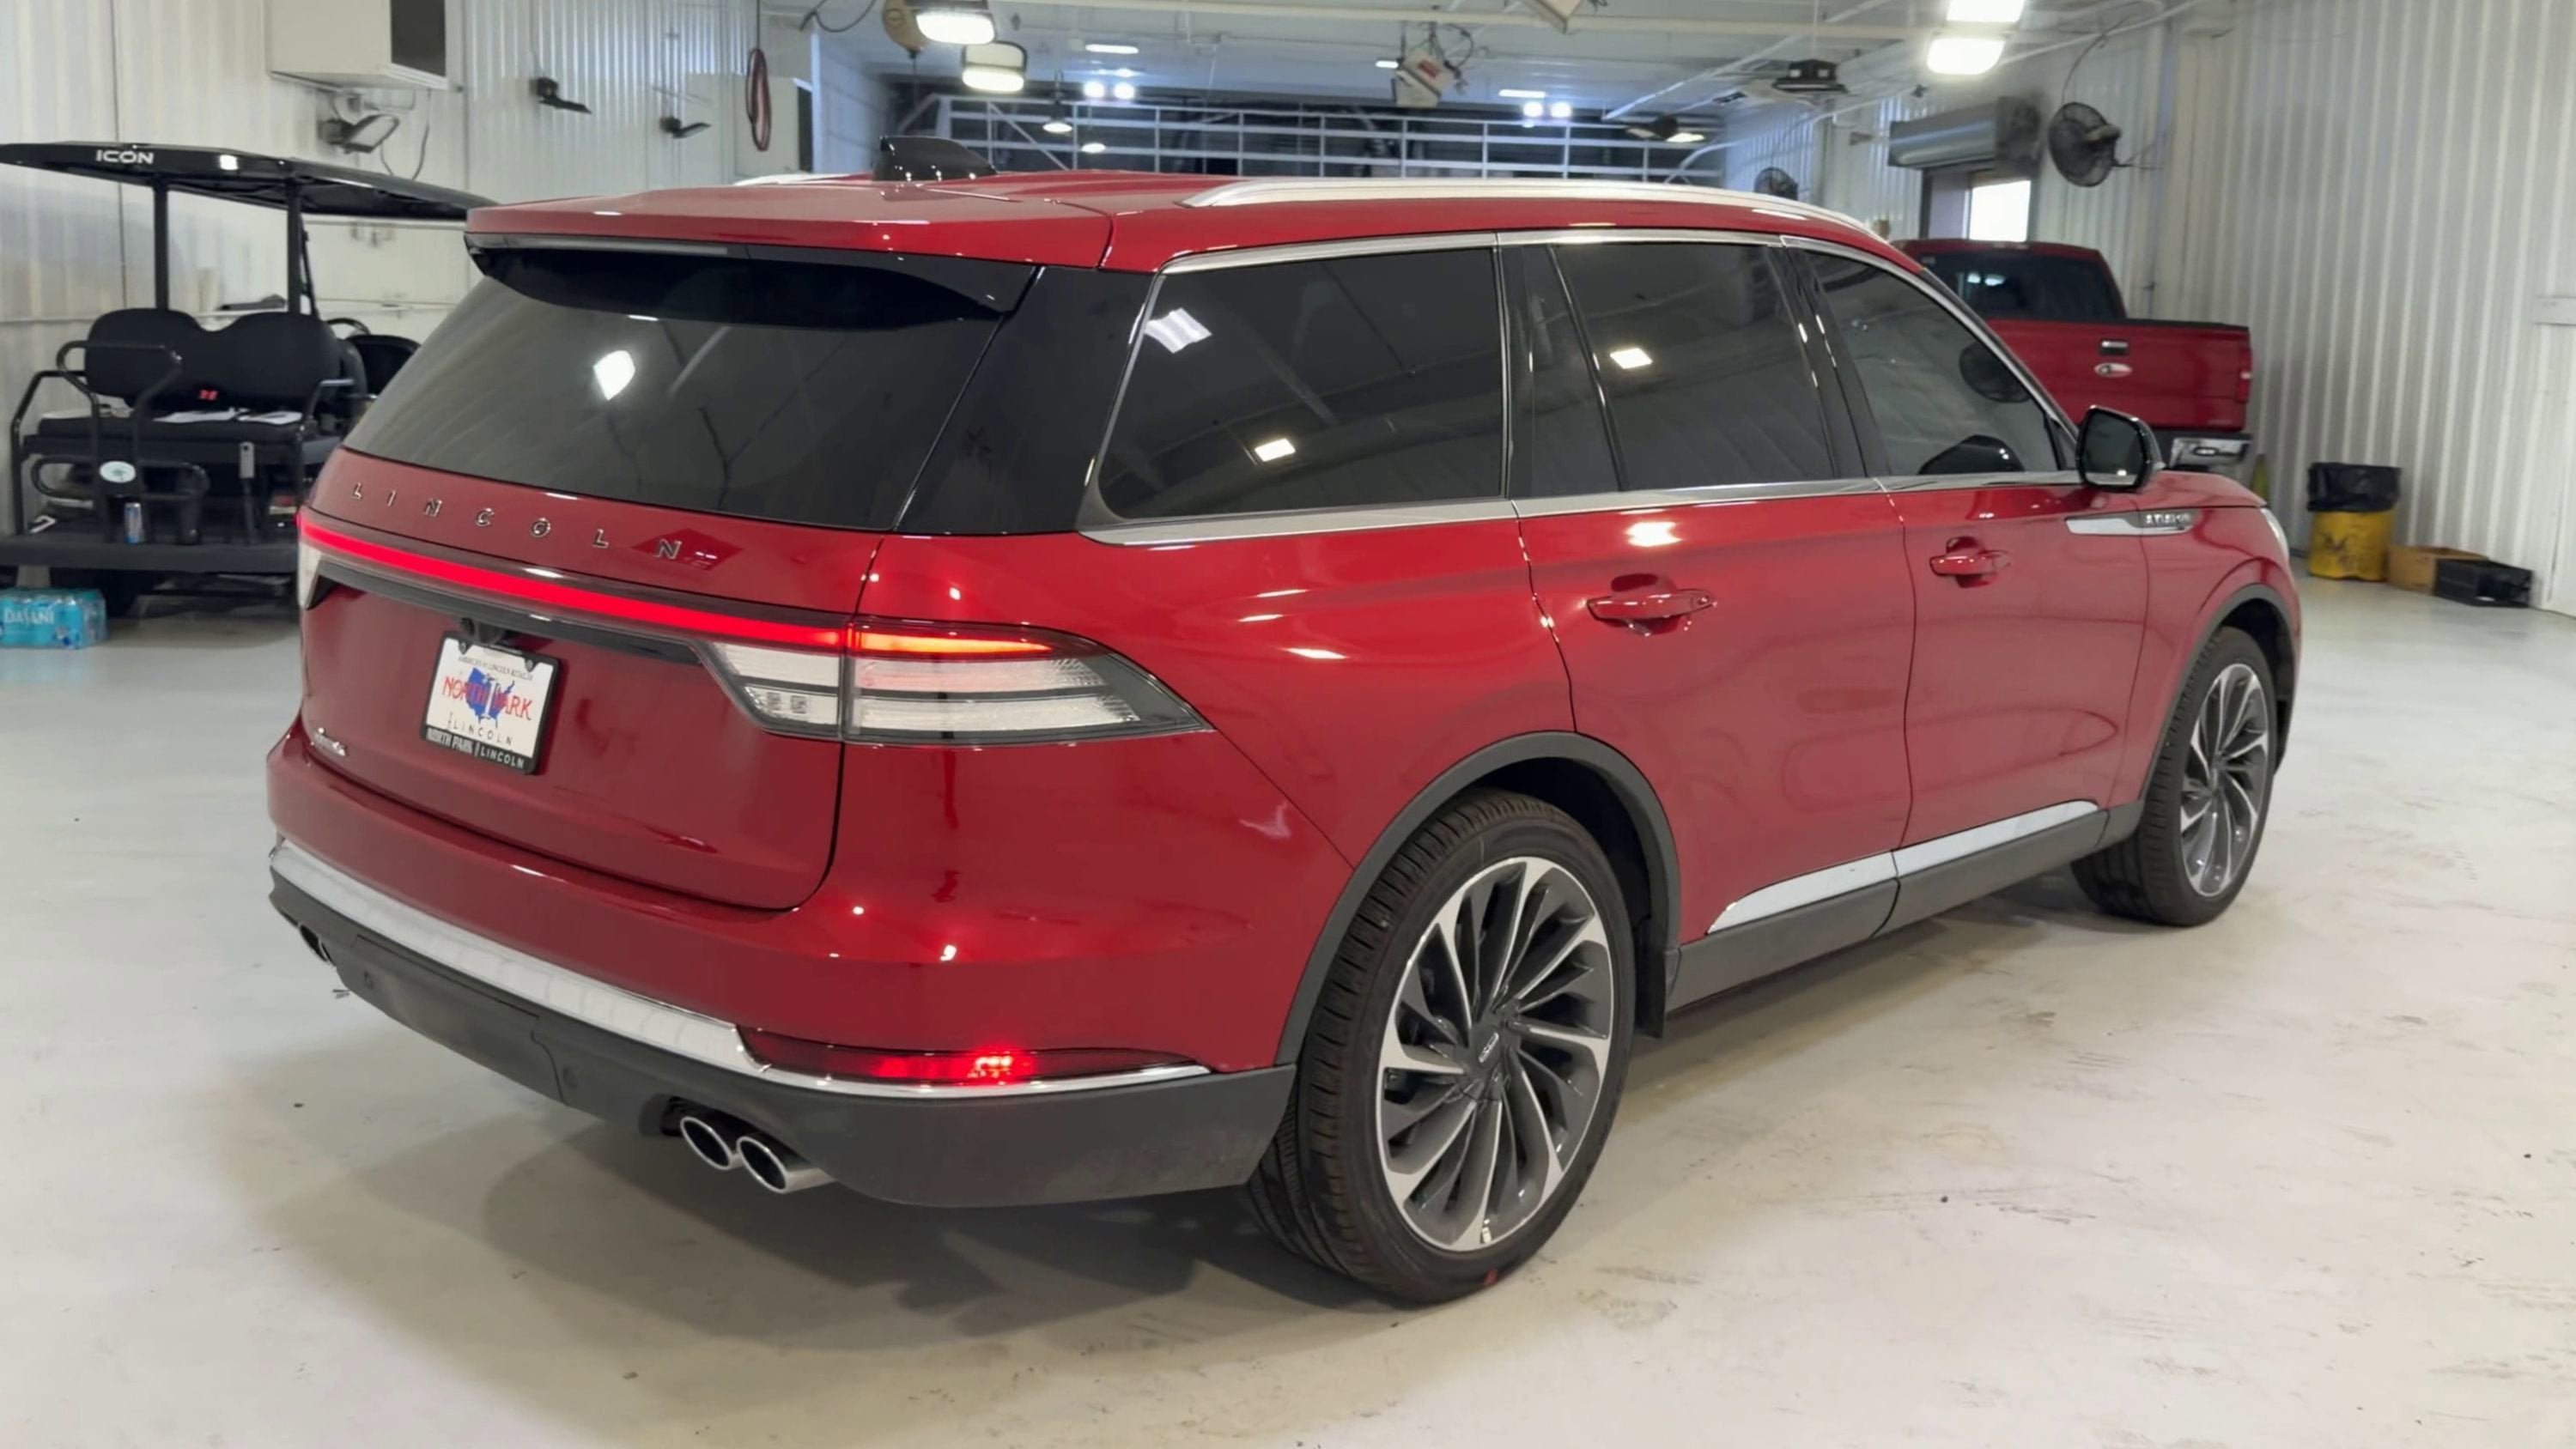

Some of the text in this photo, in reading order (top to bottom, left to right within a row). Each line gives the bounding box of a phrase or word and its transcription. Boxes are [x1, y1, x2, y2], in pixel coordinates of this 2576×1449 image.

[96, 149, 154, 164] ICON
[351, 482, 683, 560] LINCOLN
[453, 720, 513, 746] LINCOLN
[481, 746, 525, 769] LINCOLN
